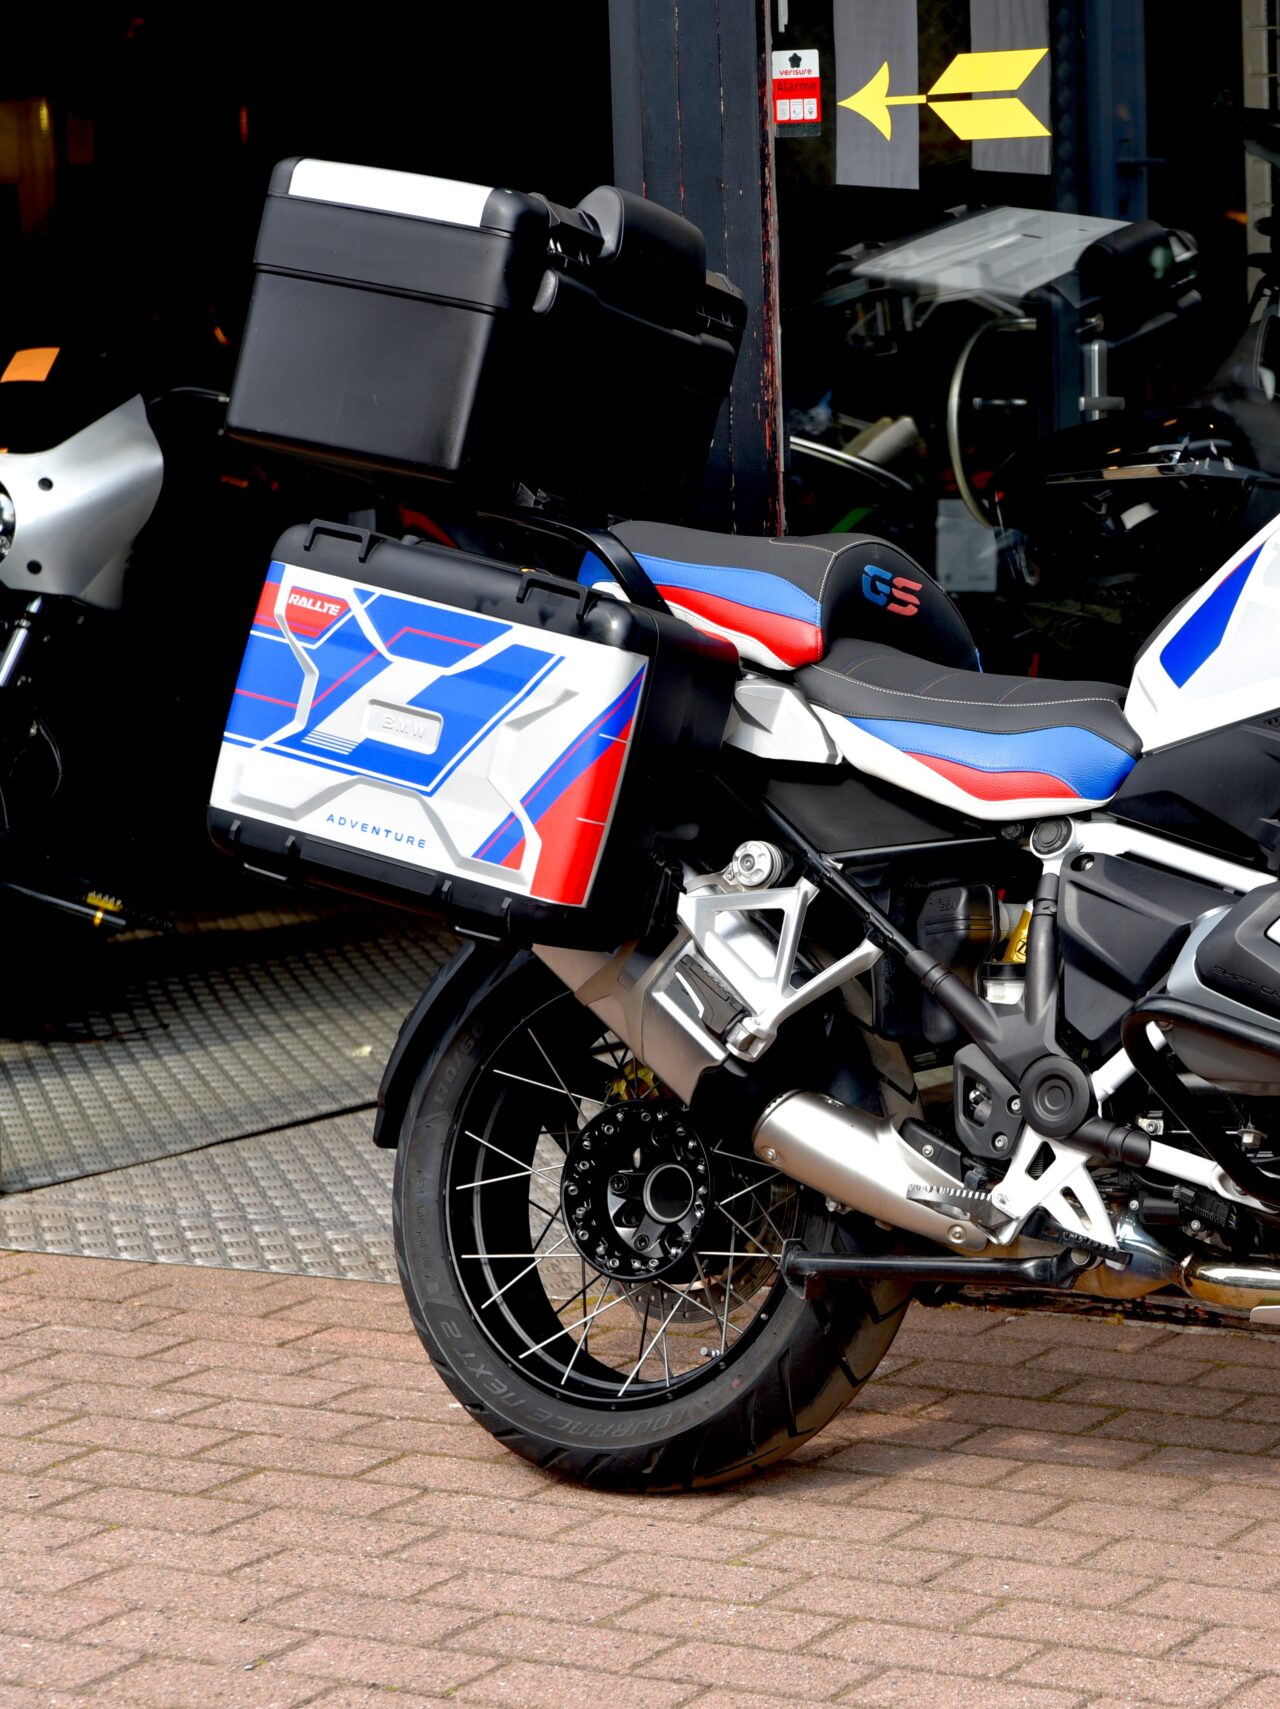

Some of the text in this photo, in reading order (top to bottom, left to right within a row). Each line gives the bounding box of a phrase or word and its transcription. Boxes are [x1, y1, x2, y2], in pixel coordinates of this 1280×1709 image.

[779, 68, 812, 76] verisure
[777, 81, 817, 93] Alarme
[862, 564, 923, 617] GS
[288, 593, 342, 616] RALLYE
[381, 714, 427, 738] BMW
[326, 813, 427, 849] ADVENTURE
